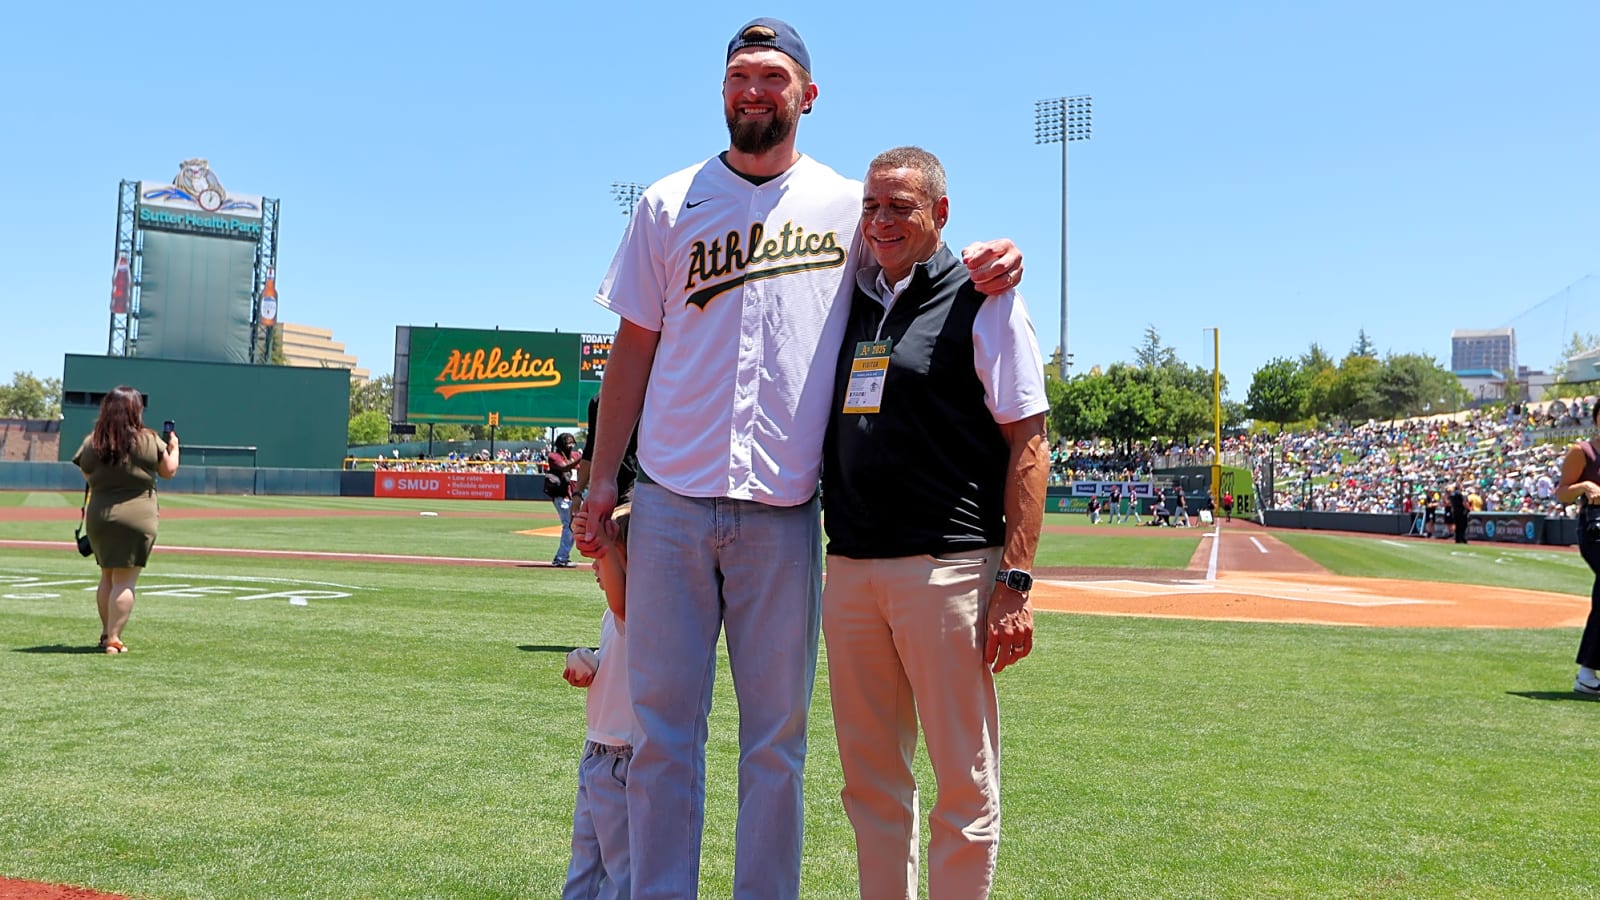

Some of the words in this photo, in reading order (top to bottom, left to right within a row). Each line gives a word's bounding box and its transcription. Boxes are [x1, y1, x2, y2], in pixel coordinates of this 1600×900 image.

[140, 207, 184, 224] Sutter
[185, 213, 228, 229] Health
[230, 219, 261, 233] Park
[685, 220, 845, 293] Athletics
[582, 335, 614, 344] TODAY'S
[435, 346, 561, 384] Athletics
[398, 479, 440, 491] SMUD
